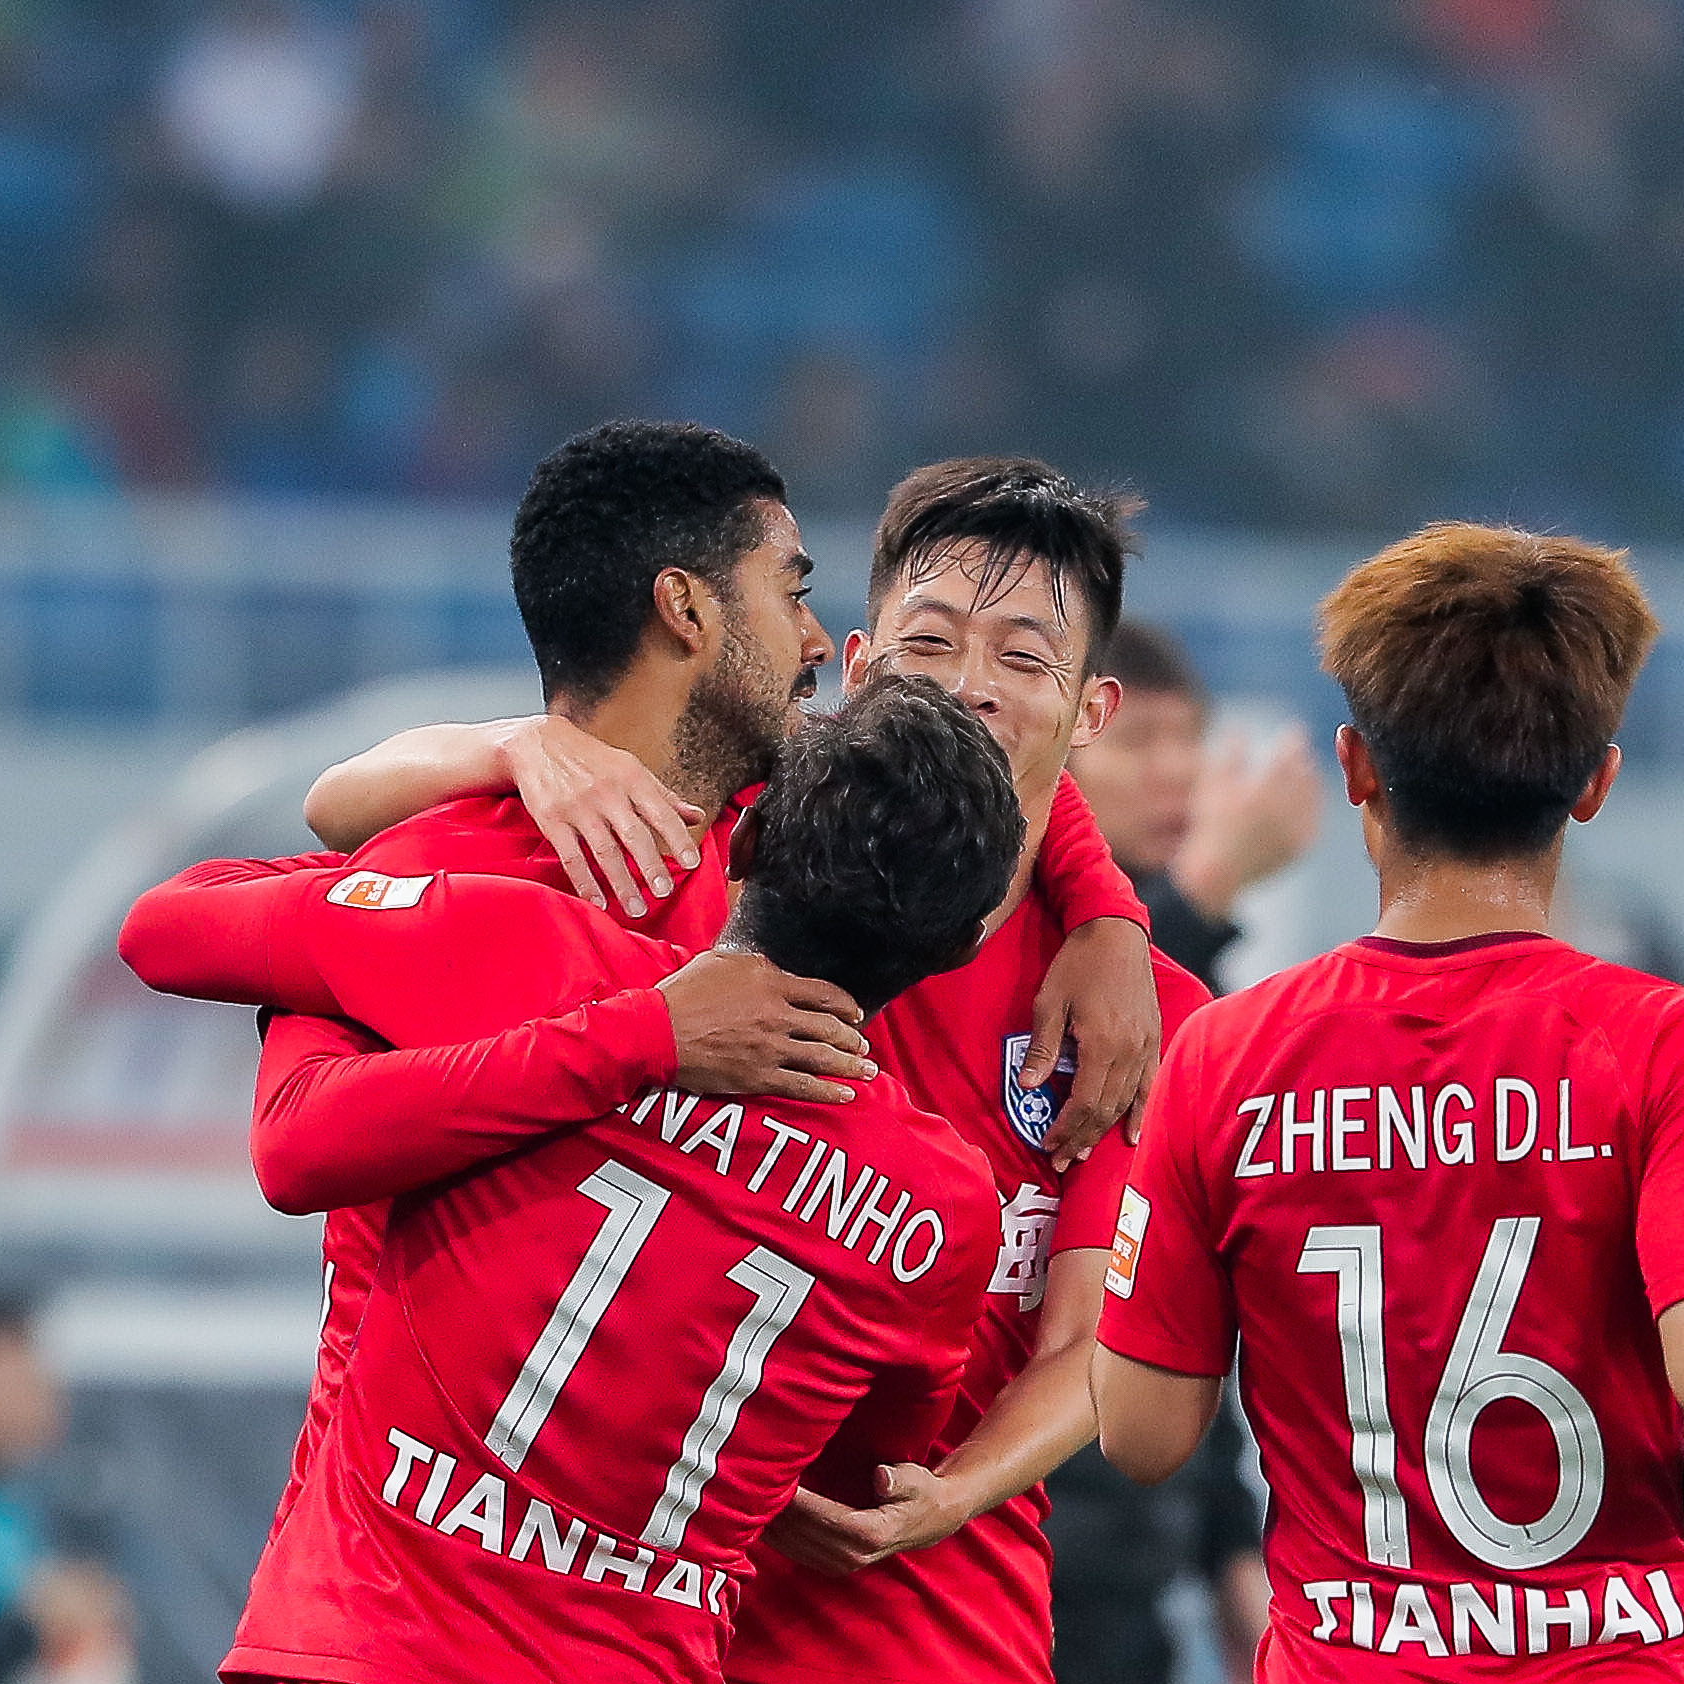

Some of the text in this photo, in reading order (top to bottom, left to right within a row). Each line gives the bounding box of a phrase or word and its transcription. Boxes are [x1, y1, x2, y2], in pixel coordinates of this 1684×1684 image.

[616, 1088, 945, 1282] NATINHO
[1234, 1078, 1613, 1178] ZHENG D.L.
[483, 1158, 816, 1551] 11
[1296, 1217, 1604, 1570] 16
[382, 1428, 728, 1616] TIANHAI
